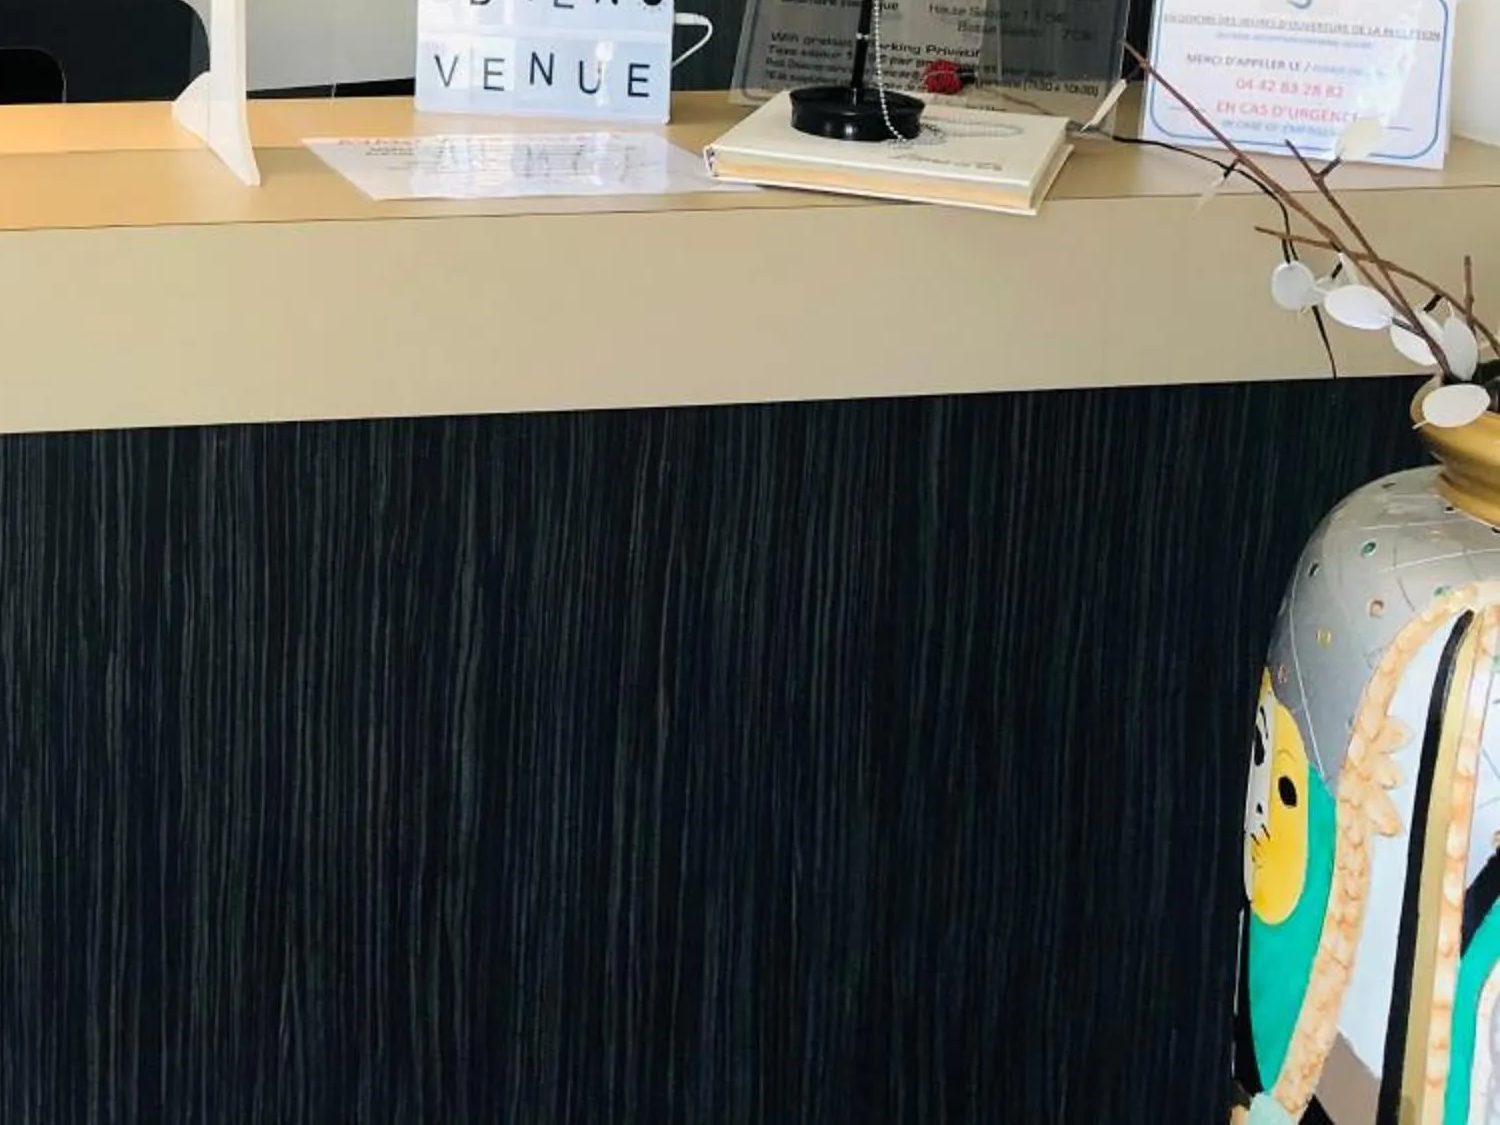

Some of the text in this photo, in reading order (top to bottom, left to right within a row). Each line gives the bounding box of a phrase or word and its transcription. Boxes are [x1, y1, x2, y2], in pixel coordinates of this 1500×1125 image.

[433, 51, 652, 98] VENUE
[1216, 101, 1236, 114] EN
[1239, 102, 1268, 116] CAS
